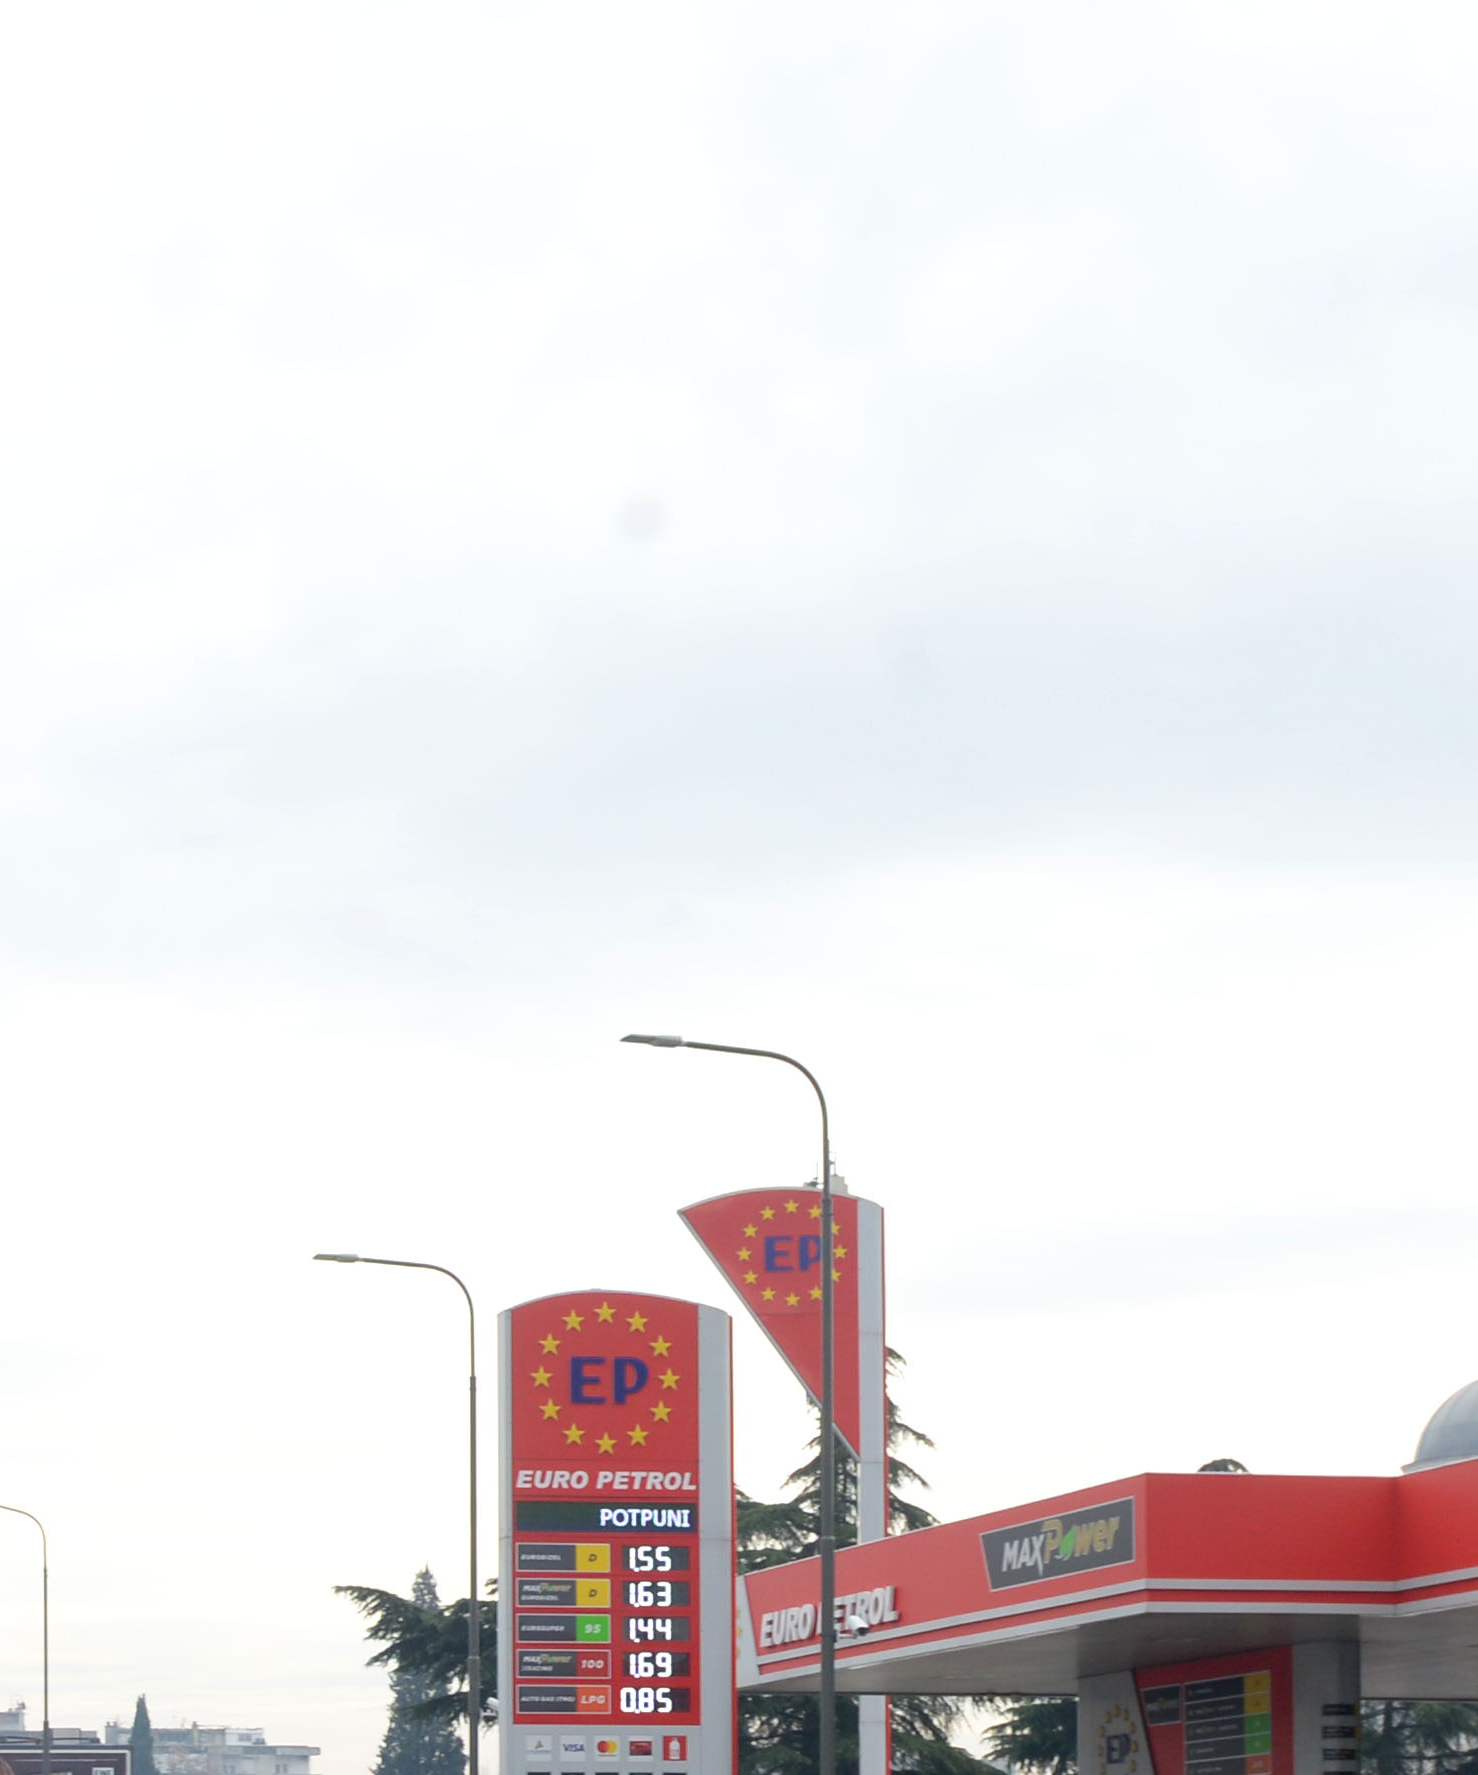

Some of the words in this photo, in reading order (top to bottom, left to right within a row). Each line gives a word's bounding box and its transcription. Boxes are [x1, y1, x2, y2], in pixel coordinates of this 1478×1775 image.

[764, 1235, 822, 1272] EP
[570, 1356, 648, 1404] EP
[516, 1470, 589, 1489] EURO
[595, 1471, 697, 1490] PETROL
[599, 1508, 690, 1528] POTPUNI
[629, 1546, 671, 1572] 1.55
[629, 1581, 671, 1607] 1.63
[760, 1604, 816, 1648] EURO
[817, 1586, 900, 1636] ETROL
[583, 1623, 602, 1634] 95
[629, 1618, 671, 1643] 1.44
[581, 1660, 604, 1669] 100
[629, 1652, 672, 1678] 1.69
[580, 1695, 606, 1705] LPG
[620, 1687, 672, 1714] 0.85
[563, 1743, 585, 1753] VISA
